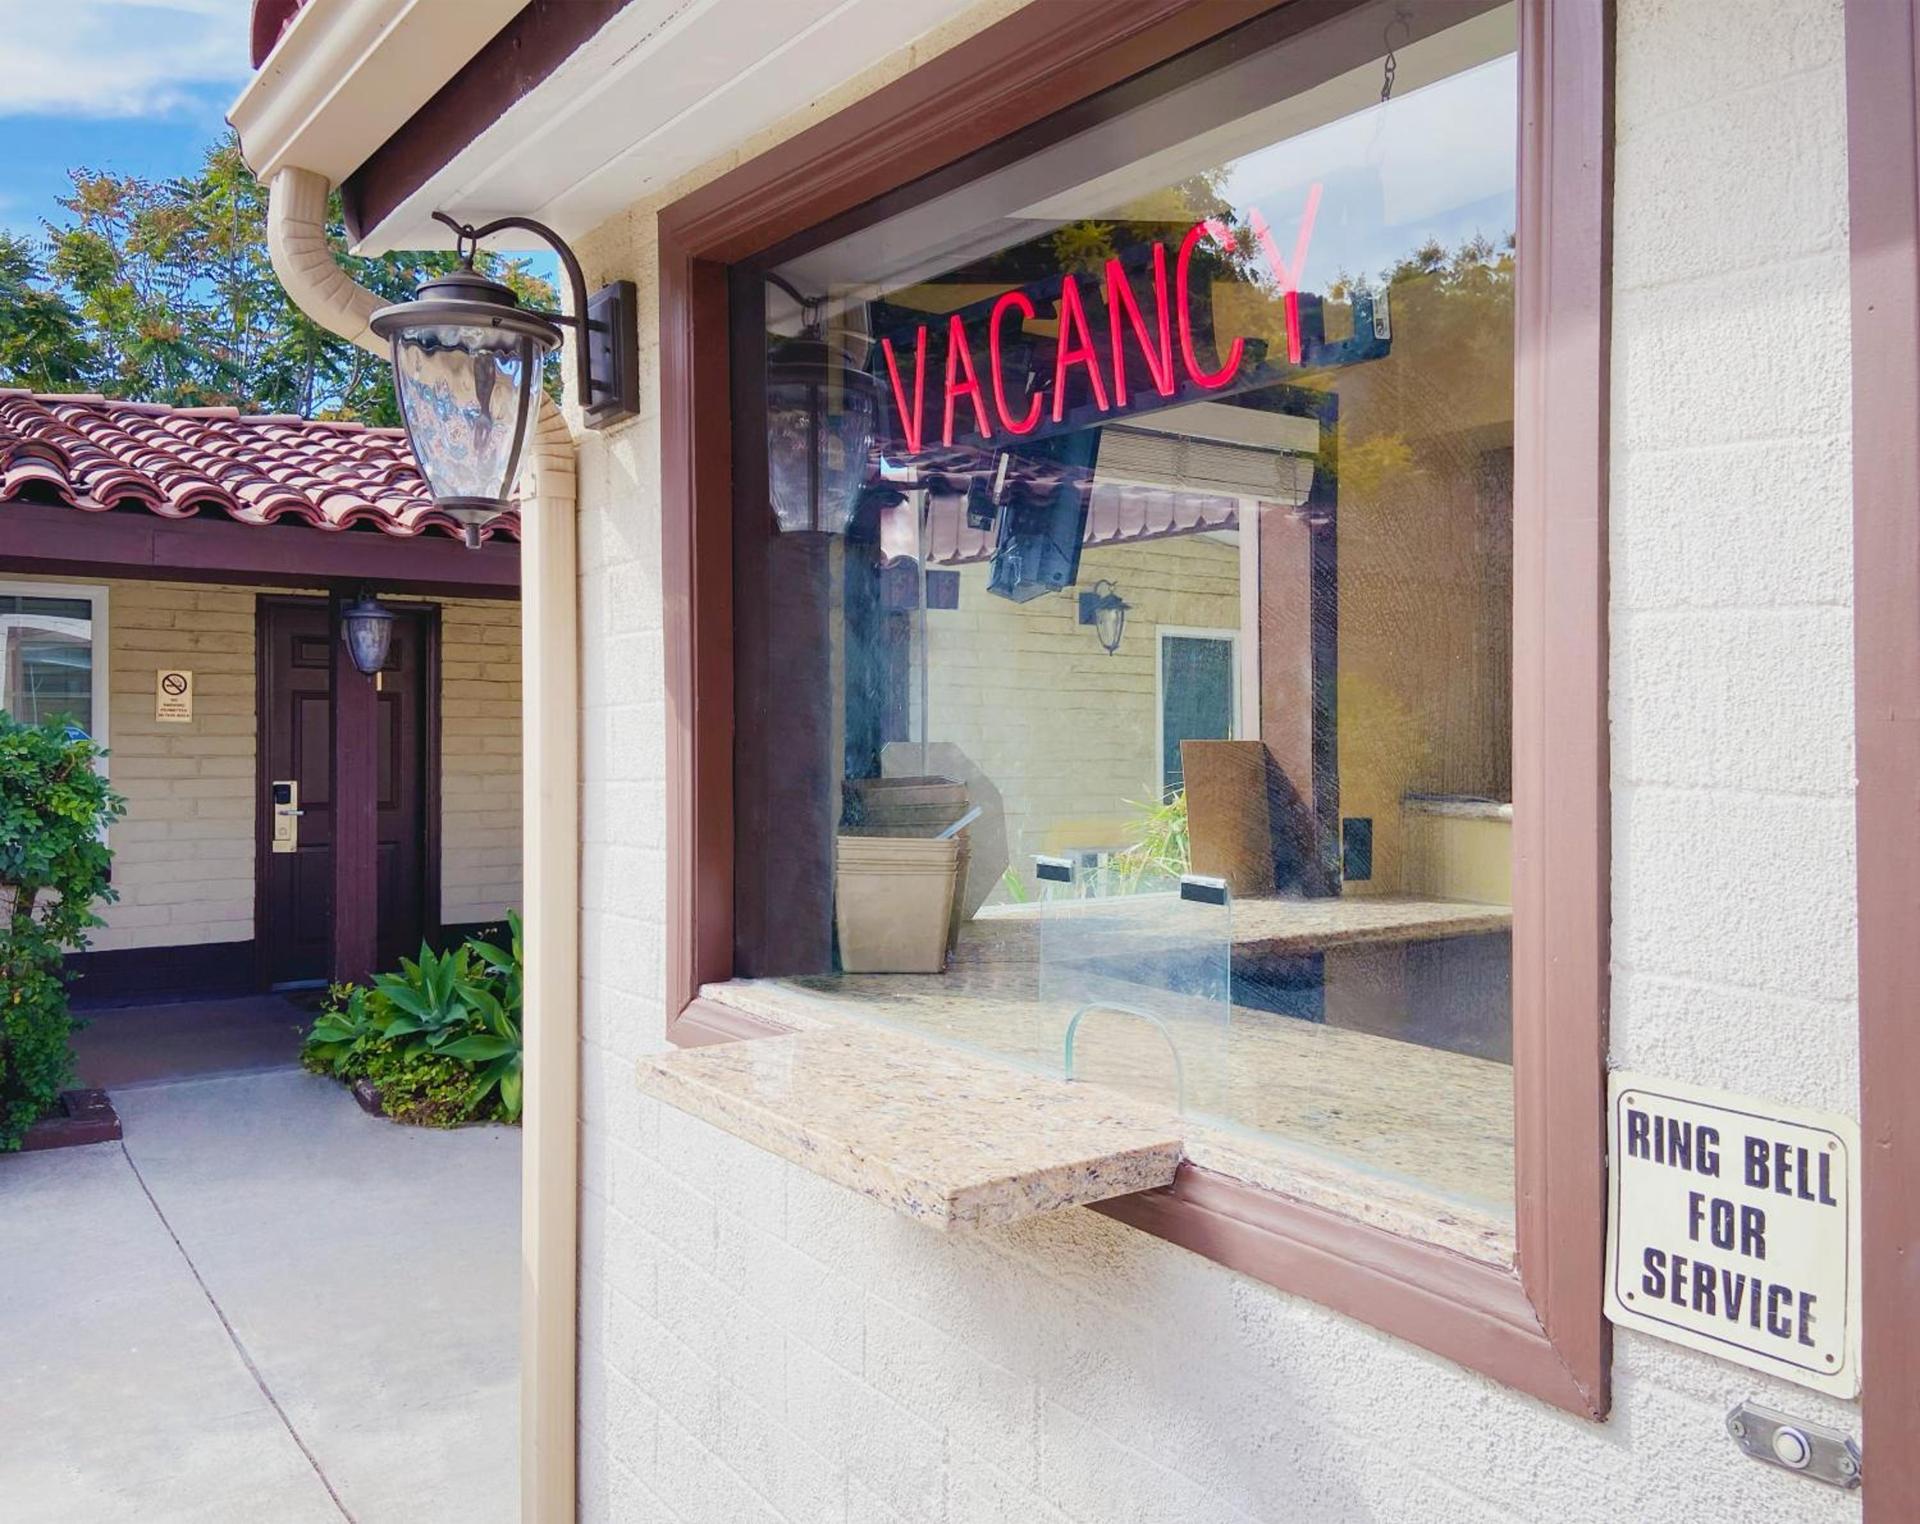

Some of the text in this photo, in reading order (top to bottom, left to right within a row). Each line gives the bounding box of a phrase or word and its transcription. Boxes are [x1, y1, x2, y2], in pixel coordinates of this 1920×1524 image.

[881, 183, 1323, 455] VACANCY
[1627, 1109, 1837, 1207] RING BELL
[1688, 1191, 1766, 1260] FOR
[1642, 1246, 1817, 1347] SERVICE
